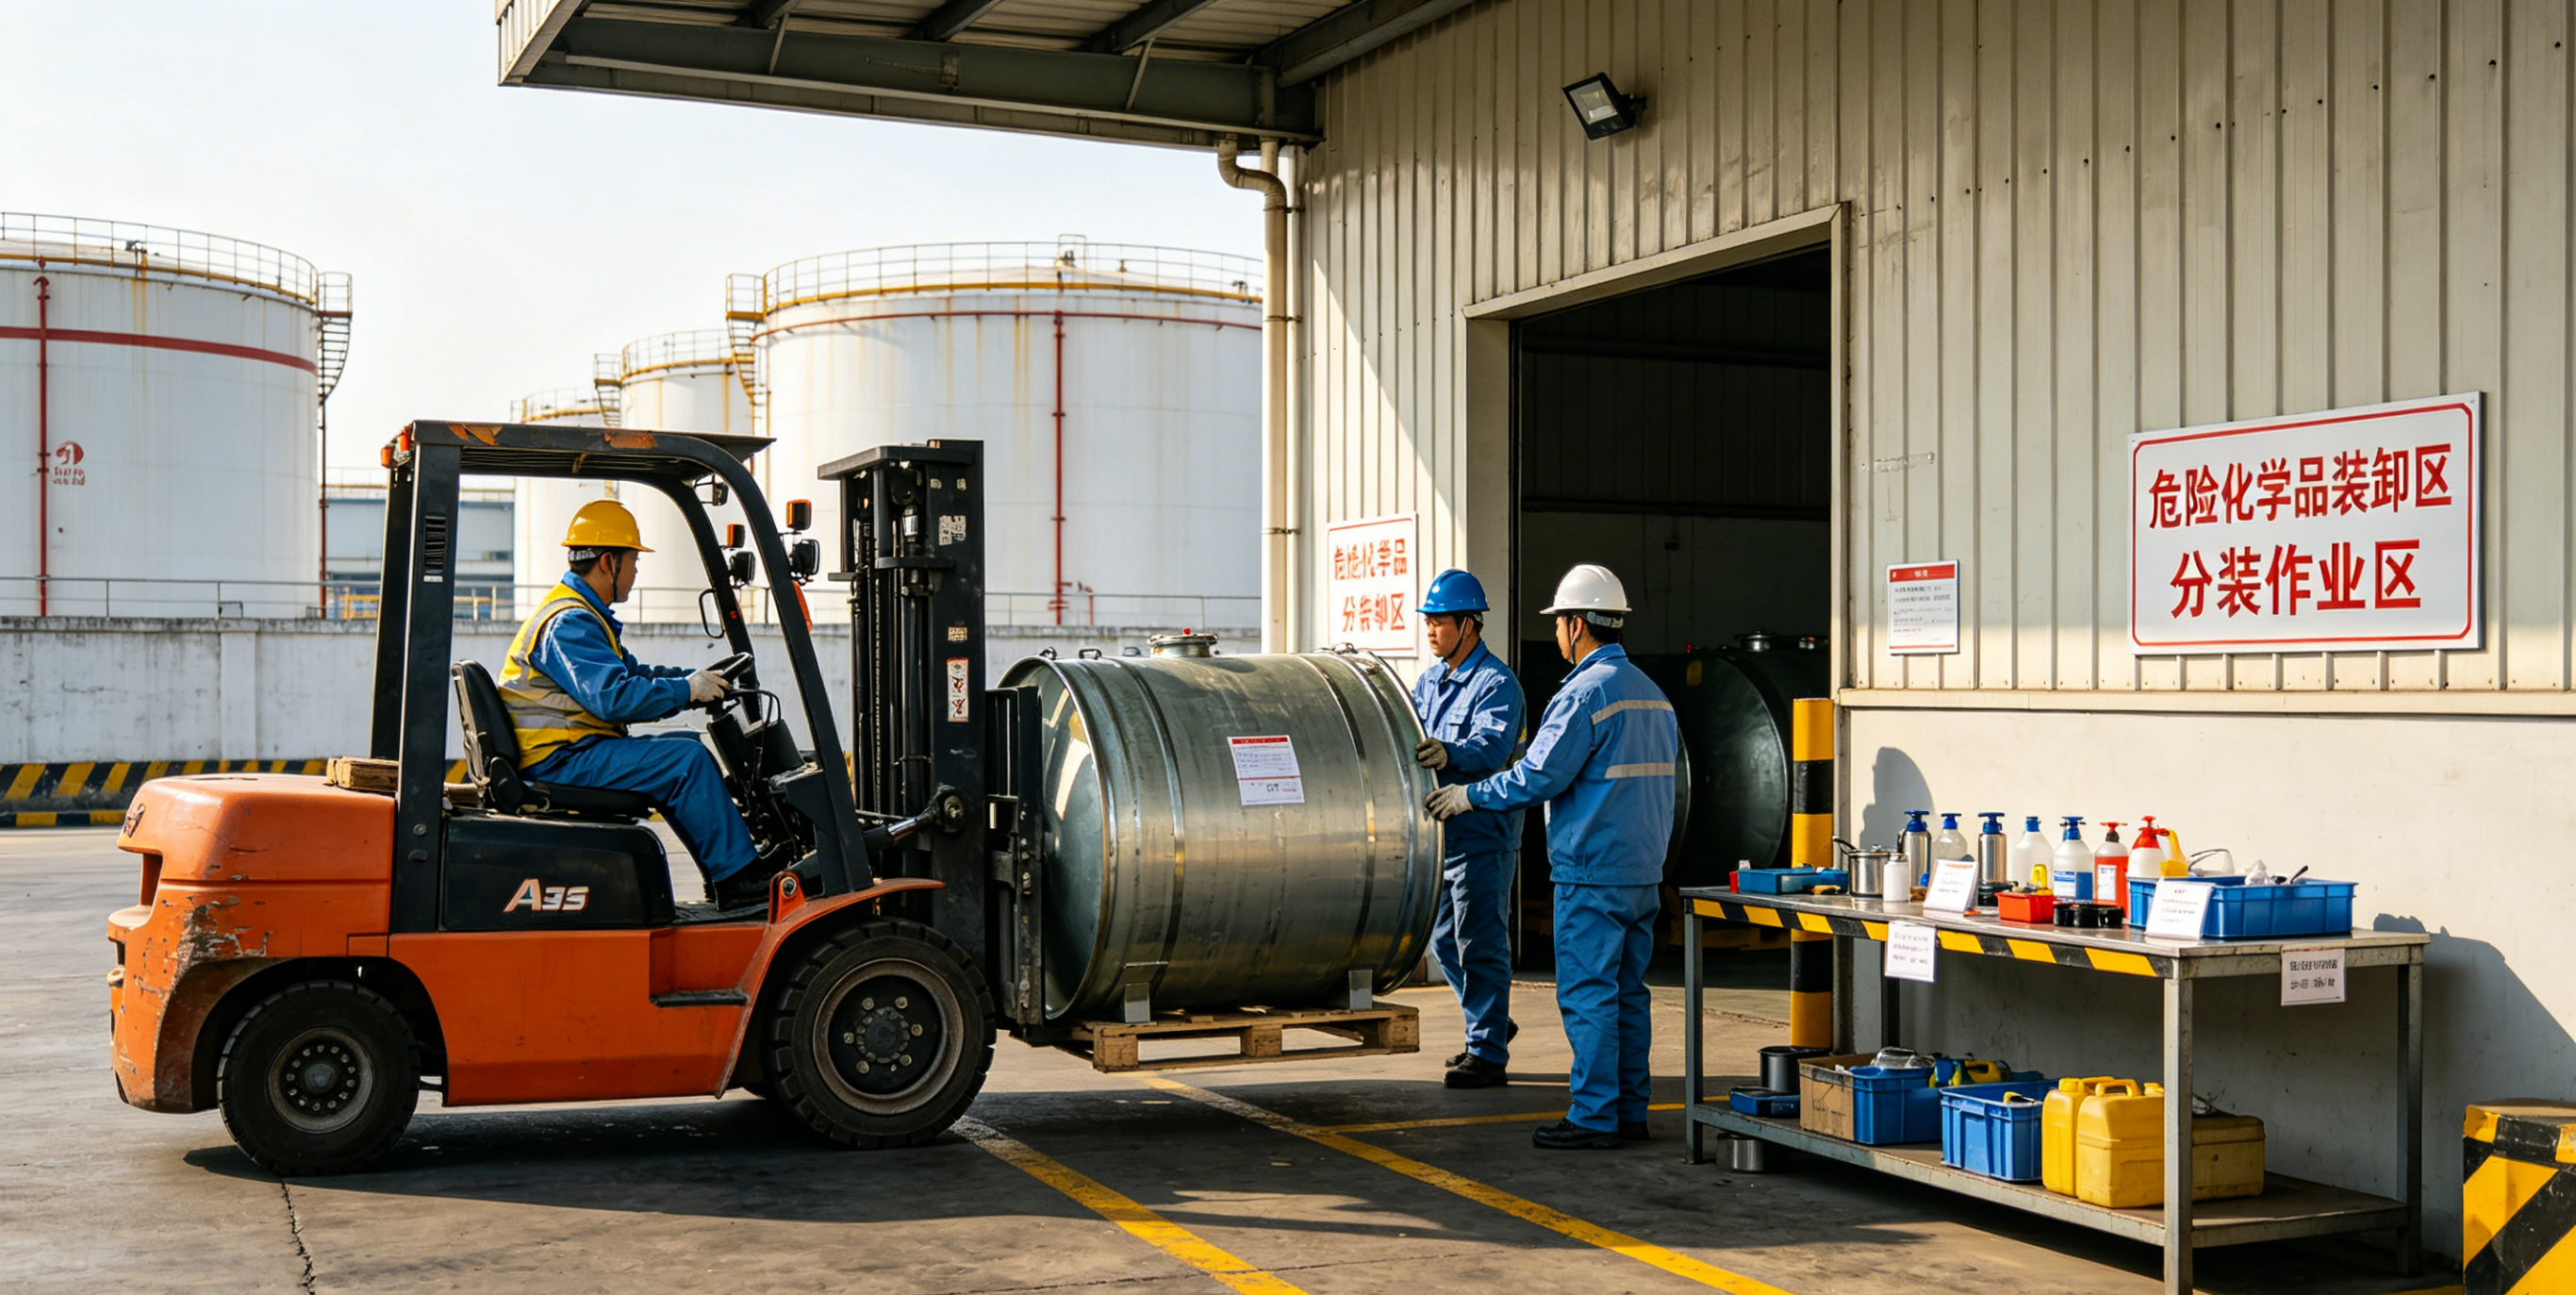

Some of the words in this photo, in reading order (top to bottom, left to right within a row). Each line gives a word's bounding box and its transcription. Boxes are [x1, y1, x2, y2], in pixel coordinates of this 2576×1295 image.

[2149, 443, 2452, 528] 危险化学品装卸区
[2170, 540, 2420, 619] 分装作业区
